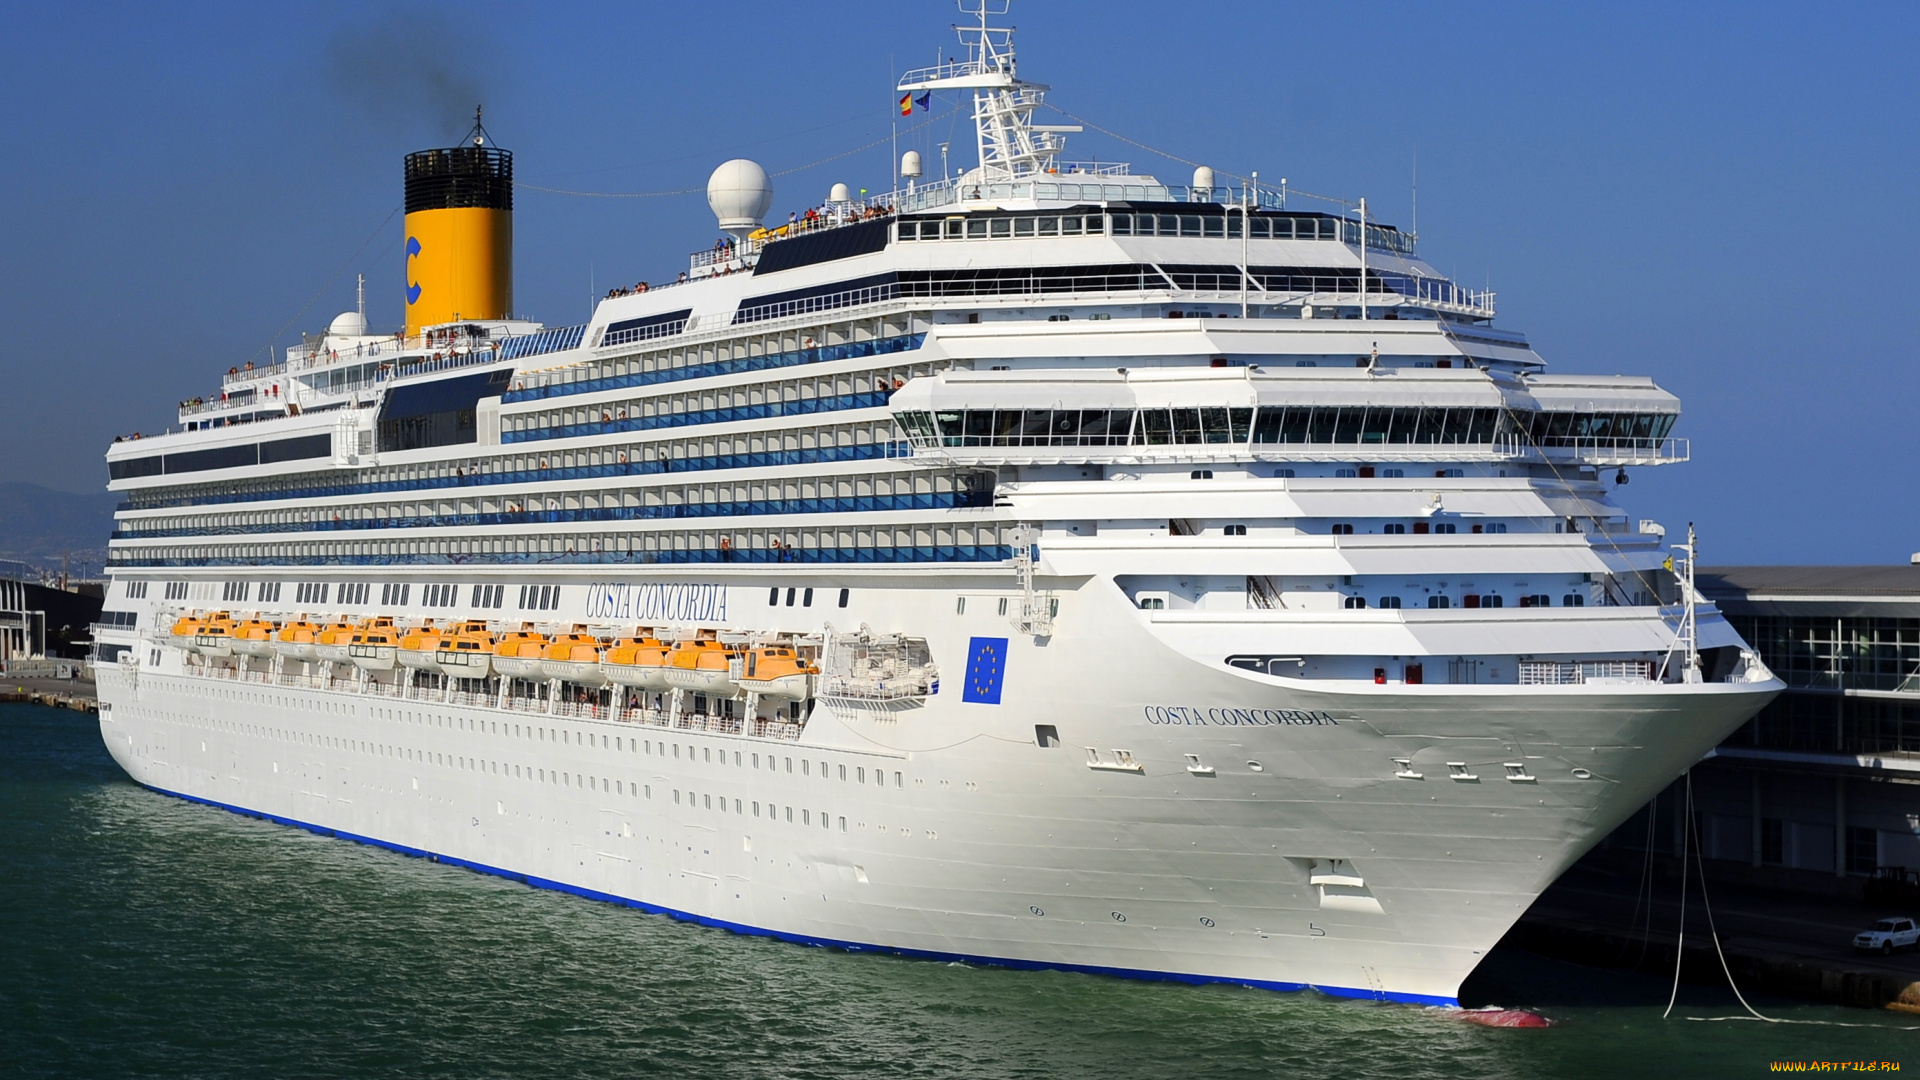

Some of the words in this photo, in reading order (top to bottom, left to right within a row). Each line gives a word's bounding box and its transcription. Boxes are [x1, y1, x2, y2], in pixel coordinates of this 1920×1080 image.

[586, 582, 632, 619] COSTA
[636, 582, 728, 622] CONCORDIA
[1144, 705, 1208, 726] COSTA
[1208, 707, 1340, 726] CONCORDIA
